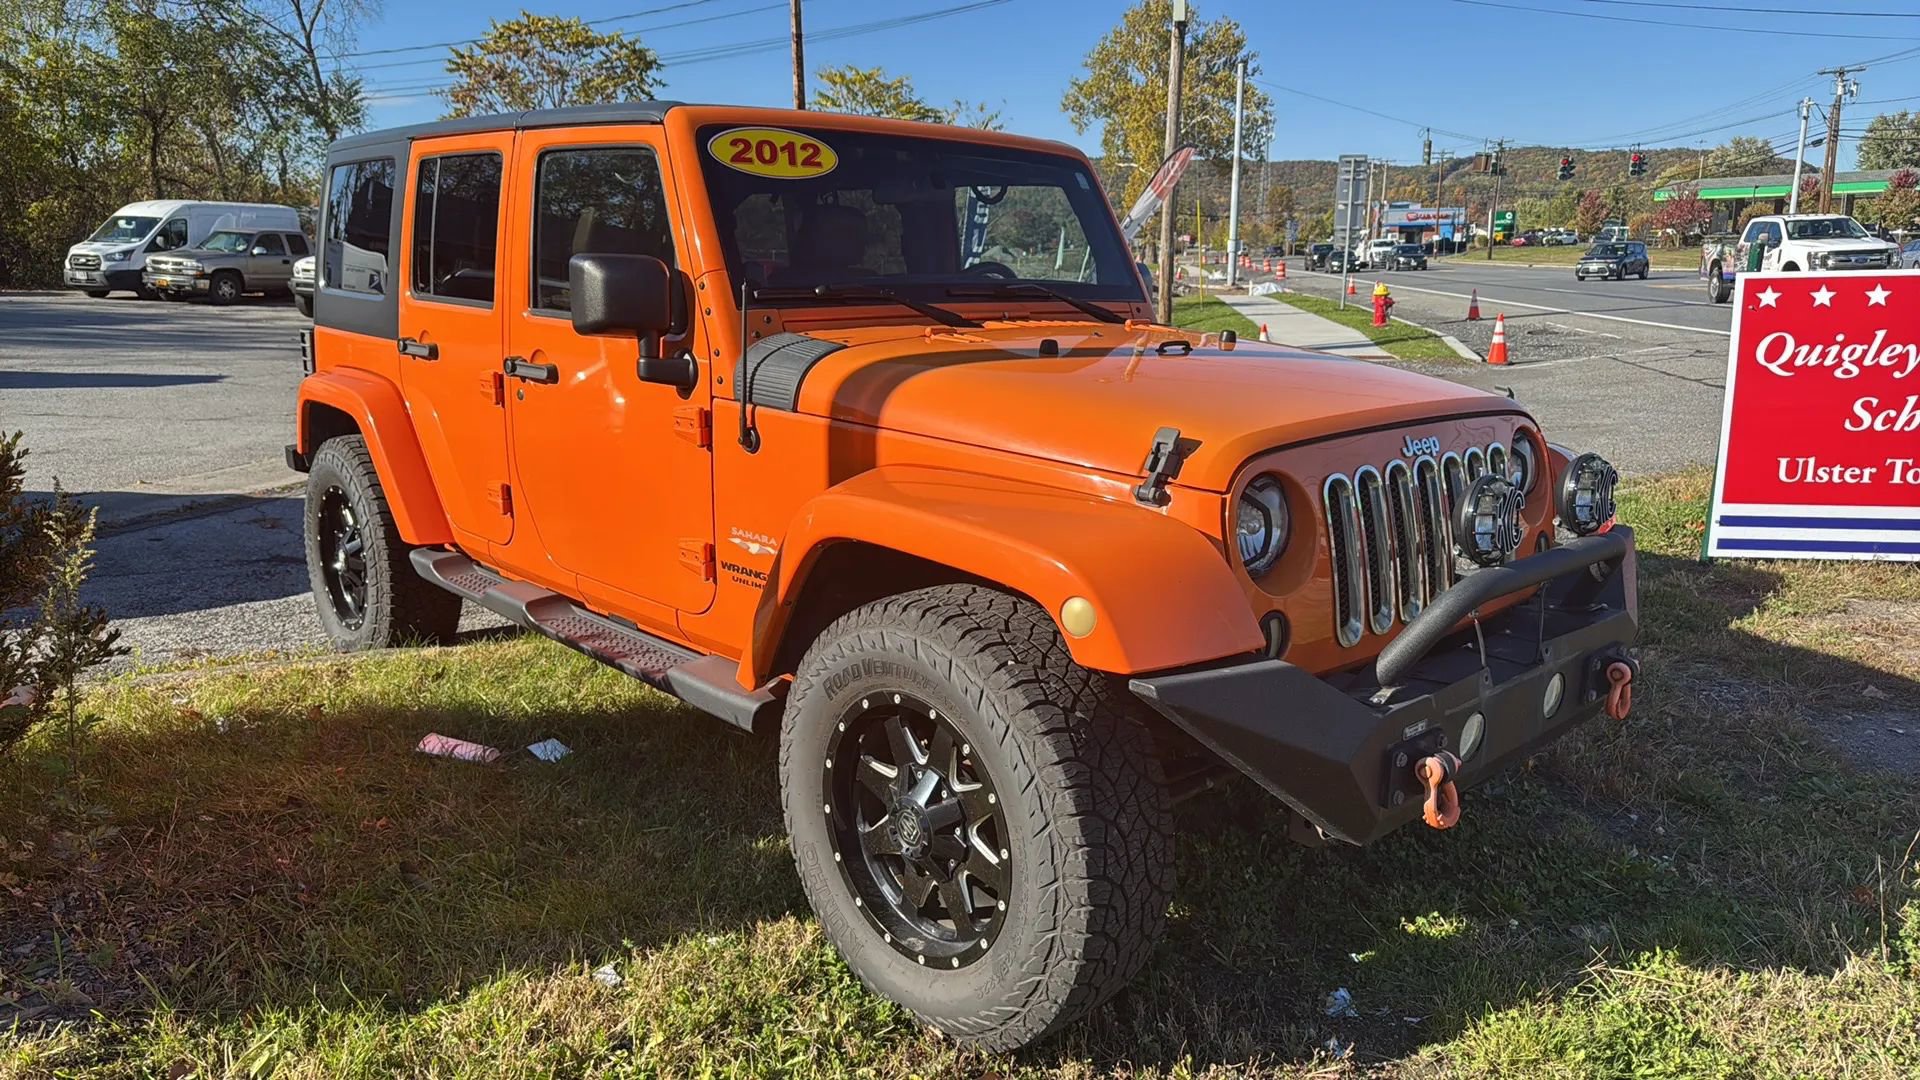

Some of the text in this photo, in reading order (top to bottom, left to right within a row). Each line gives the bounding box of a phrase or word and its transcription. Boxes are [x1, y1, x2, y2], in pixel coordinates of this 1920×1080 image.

[729, 137, 824, 169] 2012
[1755, 329, 1920, 379] Quigley
[1844, 395, 1920, 432] Sch
[1401, 435, 1440, 457] Jeep
[1777, 456, 1920, 485] Ulster To
[731, 527, 777, 546] SAHARA
